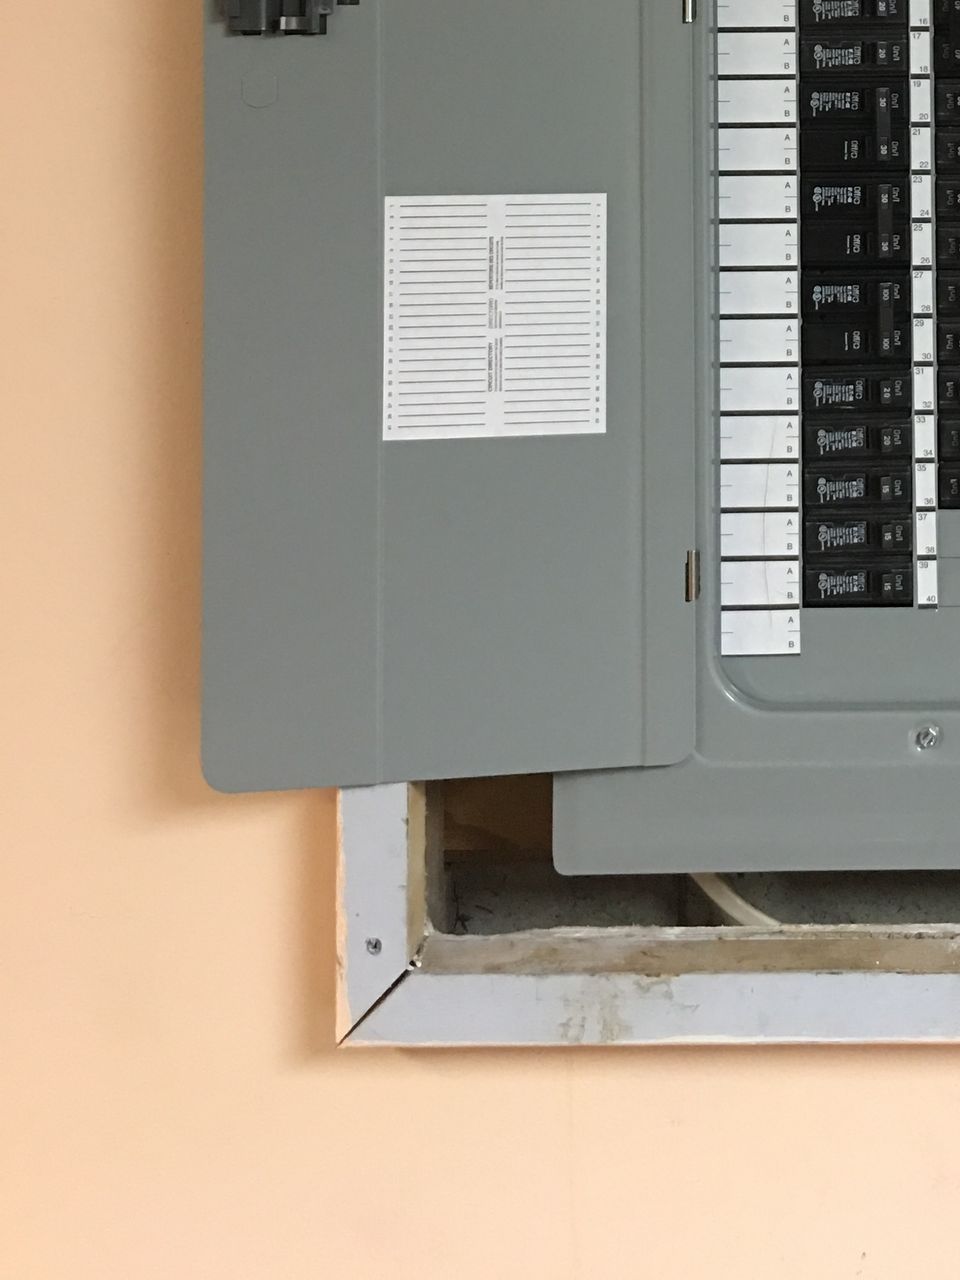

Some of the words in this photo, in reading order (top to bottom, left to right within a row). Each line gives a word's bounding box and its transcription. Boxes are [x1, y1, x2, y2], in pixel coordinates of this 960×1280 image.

[879, 1, 886, 11] 20
[878, 49, 886, 59] 20
[783, 62, 790, 70] B
[879, 97, 886, 107] 30
[880, 145, 887, 155] 30
[912, 176, 923, 184] 23
[881, 193, 888, 203] 30
[913, 223, 924, 232] 25
[881, 242, 888, 251] 30
[785, 253, 792, 261] B
[786, 348, 793, 357] B
[883, 388, 890, 398] 20
[883, 435, 891, 445] 20
[786, 445, 793, 453] B
[882, 485, 889, 493] 15
[884, 532, 892, 540] 15
[786, 542, 793, 551] B
[884, 582, 891, 591] 15
